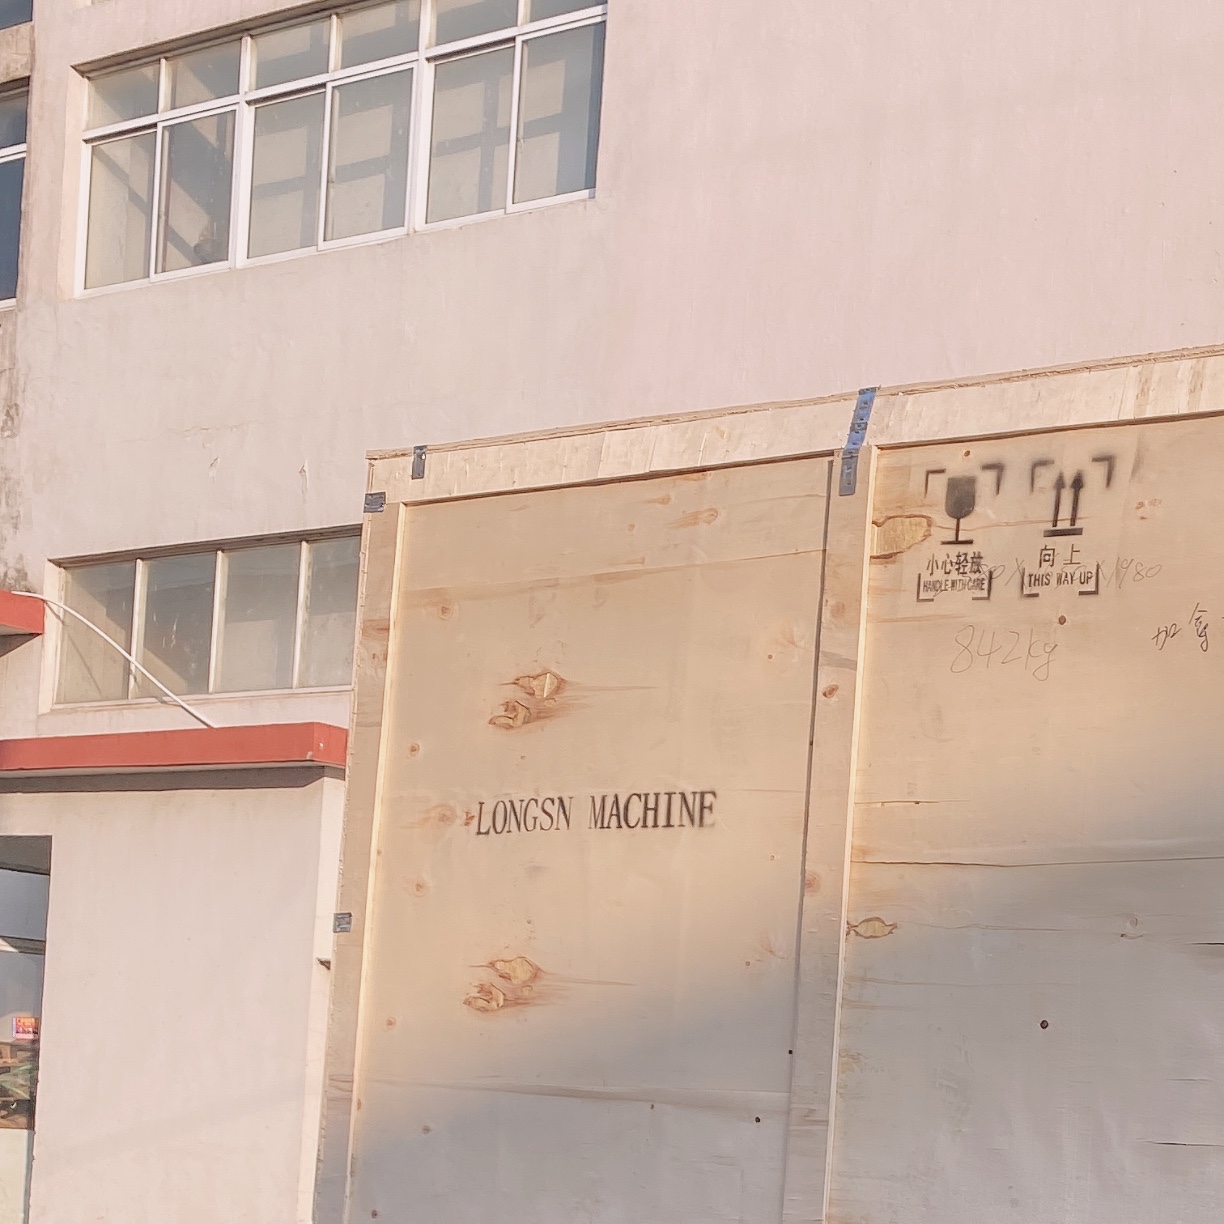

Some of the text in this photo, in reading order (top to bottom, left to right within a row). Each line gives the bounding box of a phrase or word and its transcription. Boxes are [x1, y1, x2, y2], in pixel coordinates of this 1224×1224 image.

[926, 551, 983, 577] 小心轻放
[1039, 544, 1081, 568] 向上
[922, 579, 949, 593] HANDLE
[967, 577, 986, 591] CARE
[1028, 570, 1093, 588] THIS WAY UP
[475, 790, 717, 836] LONGSN MACHINE
